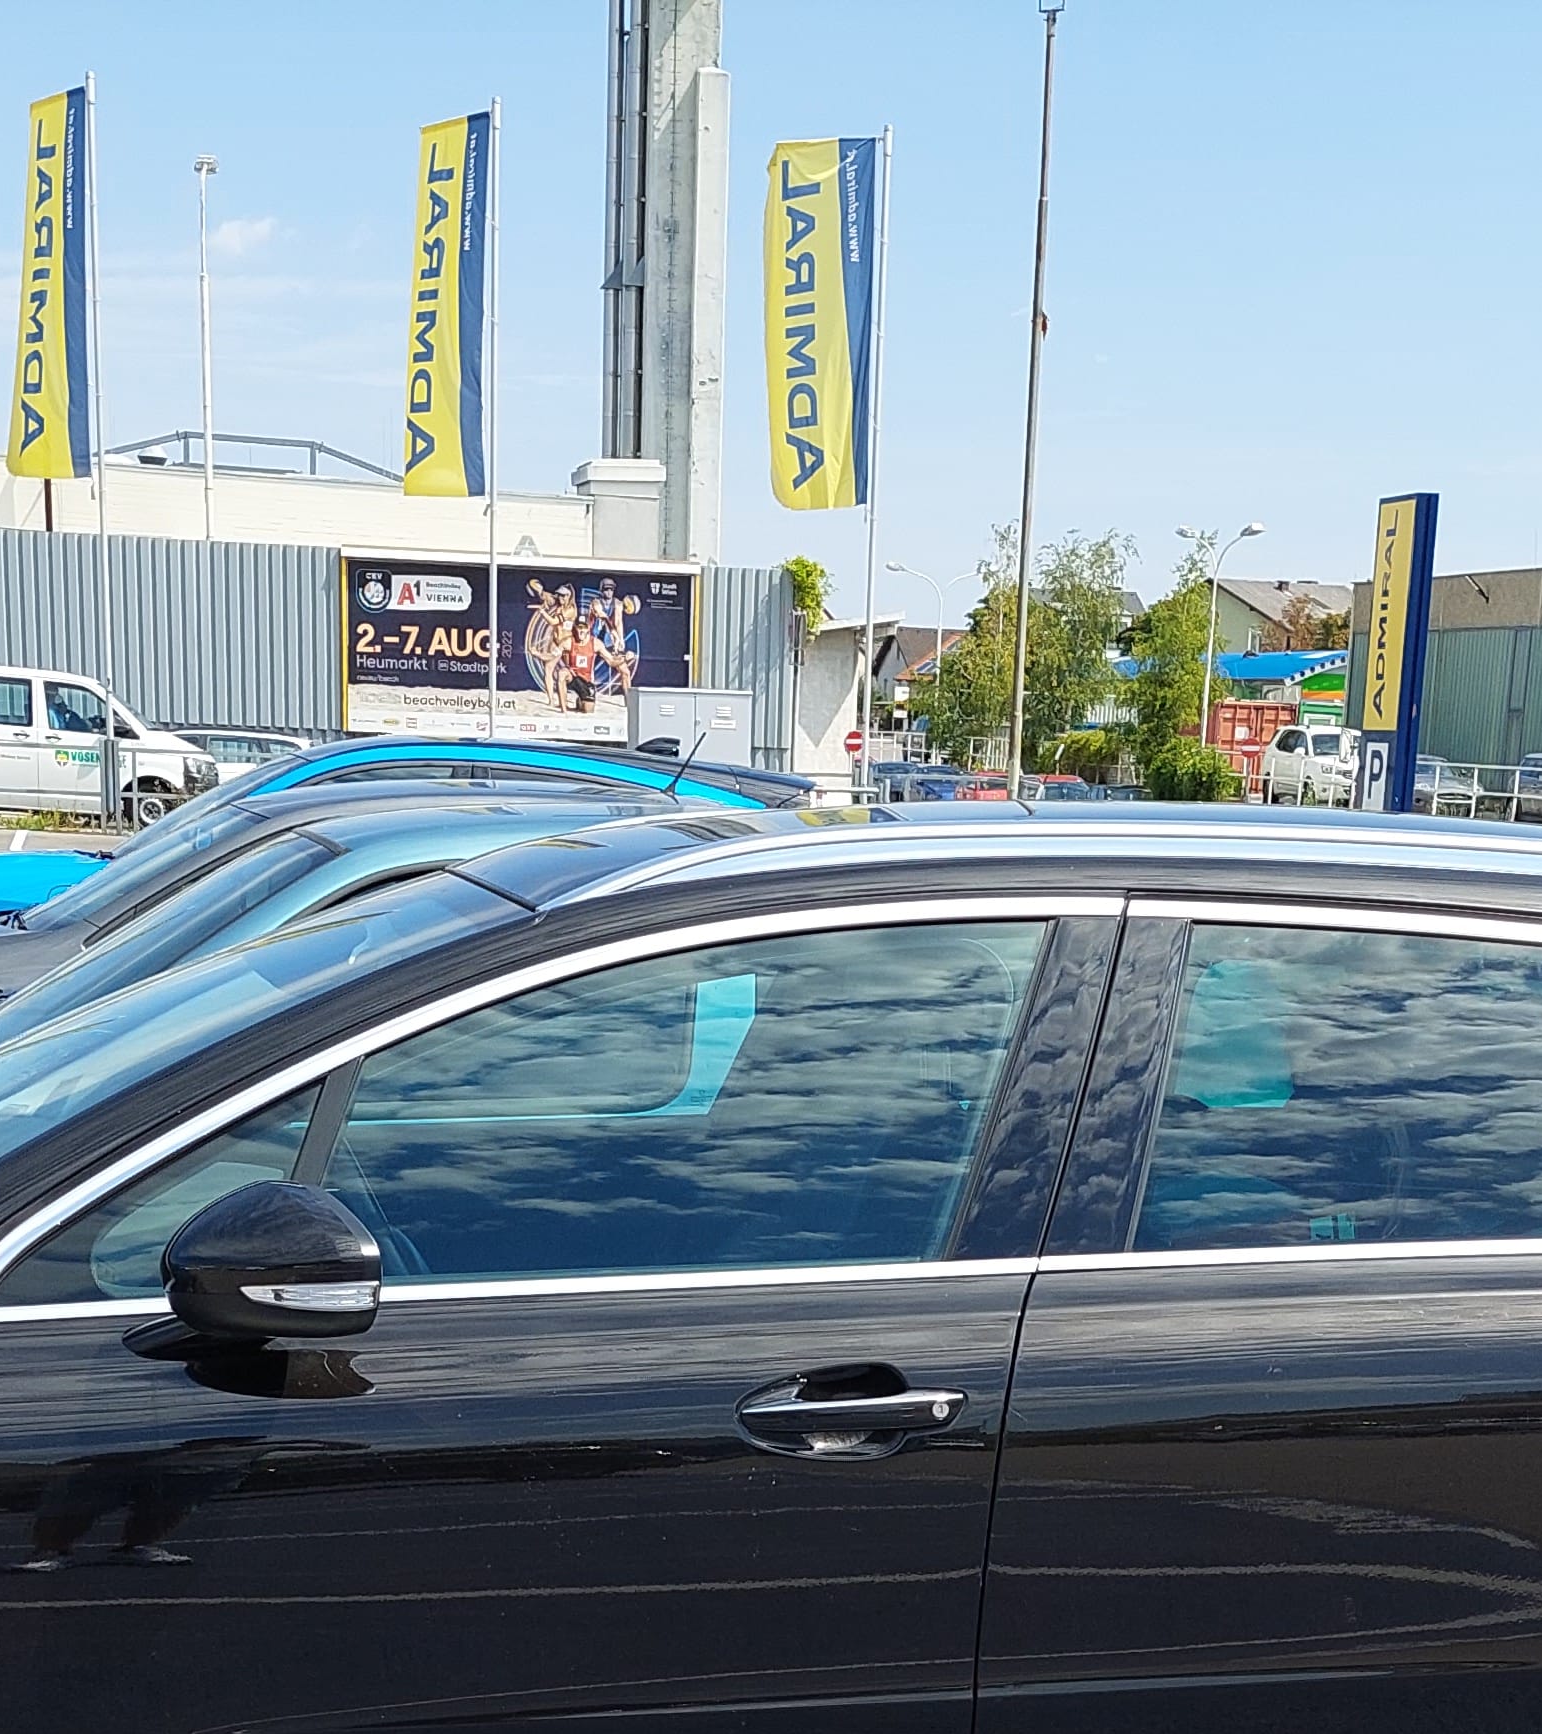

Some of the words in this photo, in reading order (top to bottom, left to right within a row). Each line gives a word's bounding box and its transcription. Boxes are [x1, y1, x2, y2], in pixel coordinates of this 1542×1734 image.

[396, 579, 421, 606] A1
[1372, 508, 1399, 720] ADMIRAL
[501, 630, 513, 658] 2022
[356, 653, 429, 671] Heumarkt
[449, 660, 508, 676] Stadtprk
[403, 693, 517, 710] beachvolleybal.at
[1367, 749, 1383, 799] P
